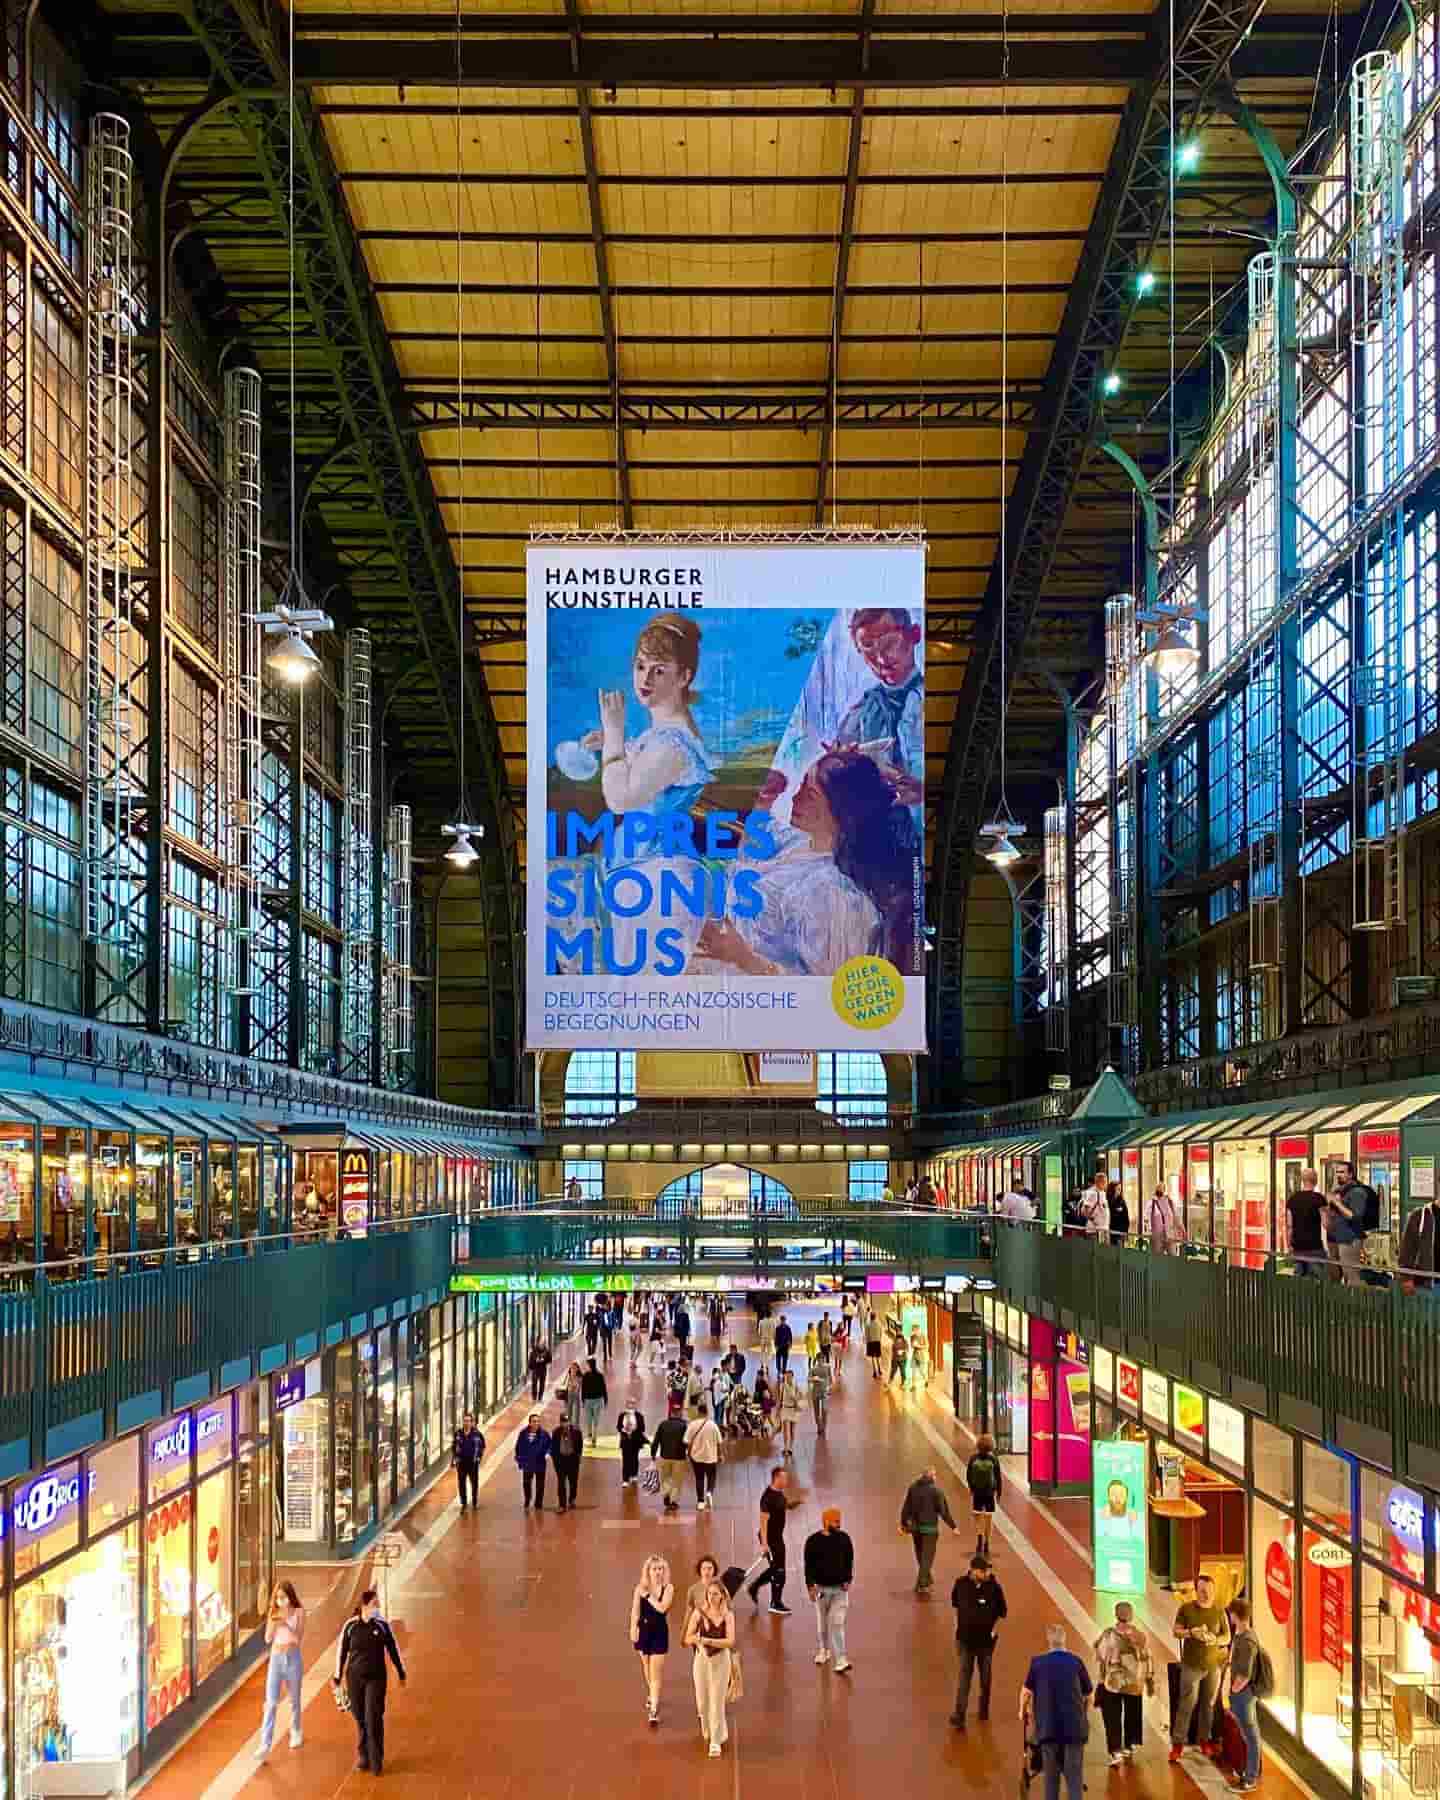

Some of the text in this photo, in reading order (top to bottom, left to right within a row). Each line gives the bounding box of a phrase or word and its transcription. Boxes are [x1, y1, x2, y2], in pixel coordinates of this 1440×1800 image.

[546, 568, 703, 584] HAMBURGER
[546, 592, 703, 608] KUNSTHALLE
[546, 811, 774, 859] IMPRES
[546, 868, 764, 918] SIONIS
[546, 928, 686, 976] MUS
[847, 964, 880, 981] HIER
[544, 991, 798, 1009] DEUTSCH-FRANZÖSISCHE
[845, 987, 896, 1009] GEGEN
[855, 1003, 891, 1021] WART
[544, 1013, 700, 1031] BEGEGNUNGEN
